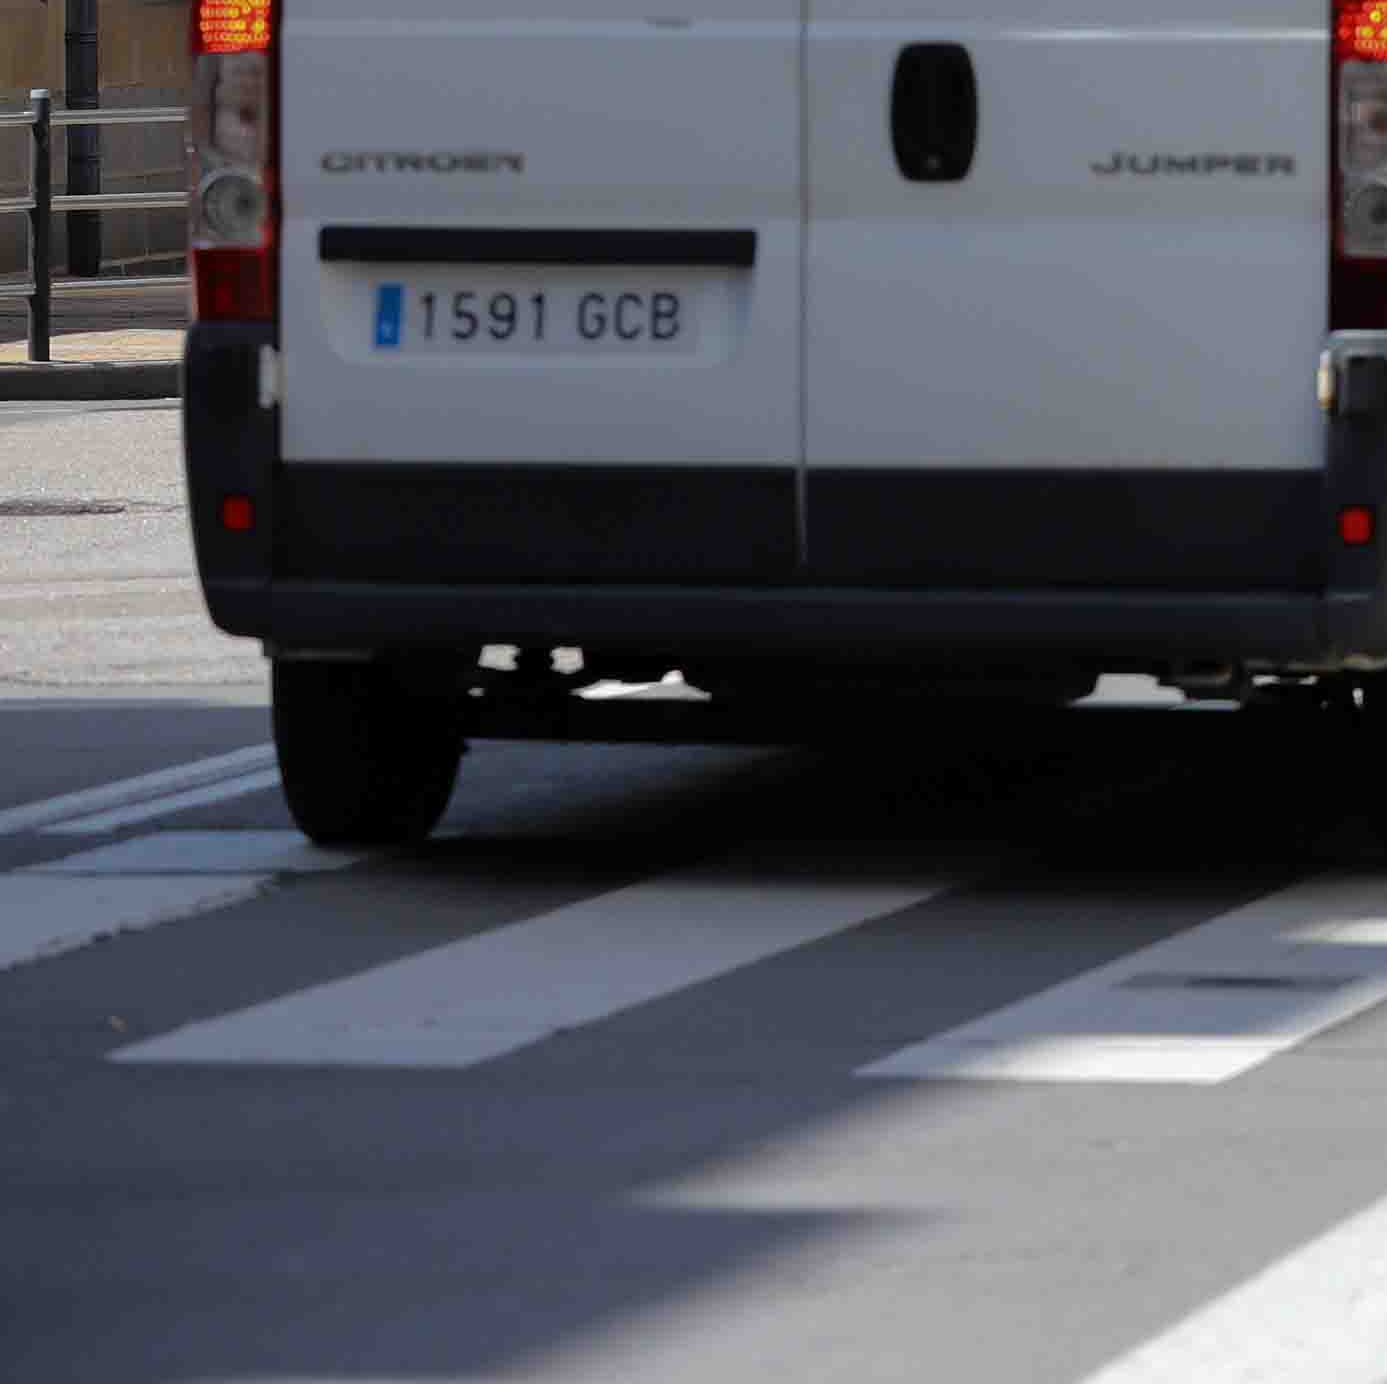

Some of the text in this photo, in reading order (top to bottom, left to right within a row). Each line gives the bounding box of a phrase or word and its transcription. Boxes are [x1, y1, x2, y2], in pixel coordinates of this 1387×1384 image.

[1090, 152, 1297, 176] JUMPER
[420, 290, 681, 341] 1591 GCB
